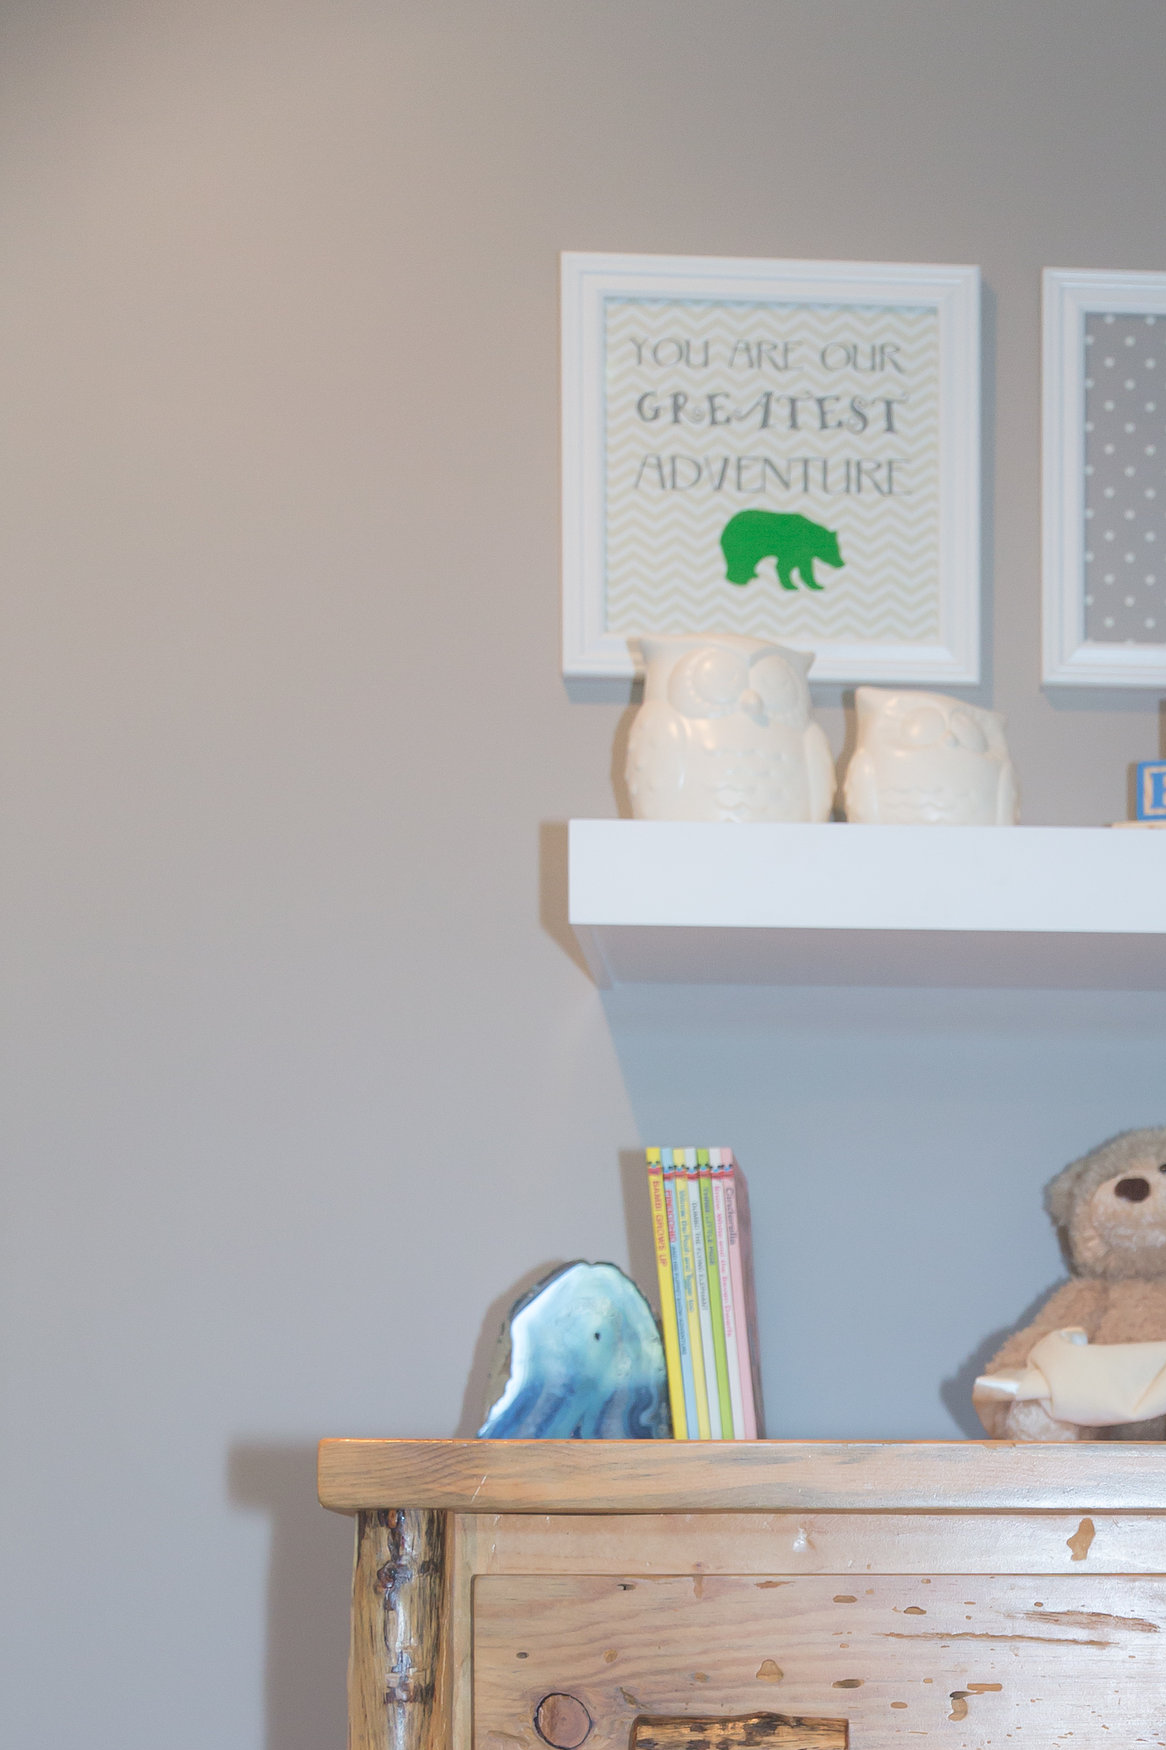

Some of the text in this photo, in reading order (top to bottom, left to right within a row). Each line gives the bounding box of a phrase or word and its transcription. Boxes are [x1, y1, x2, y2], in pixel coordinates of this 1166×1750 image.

[630, 337, 906, 373] YOU ARE OUR
[636, 390, 911, 434] GREATEST
[634, 453, 913, 497] ADVENTURE
[653, 1180, 661, 1210] BAMBI
[656, 1214, 665, 1250] GROWS
[725, 1187, 738, 1245] Cinderella
[659, 1254, 667, 1266] UP
